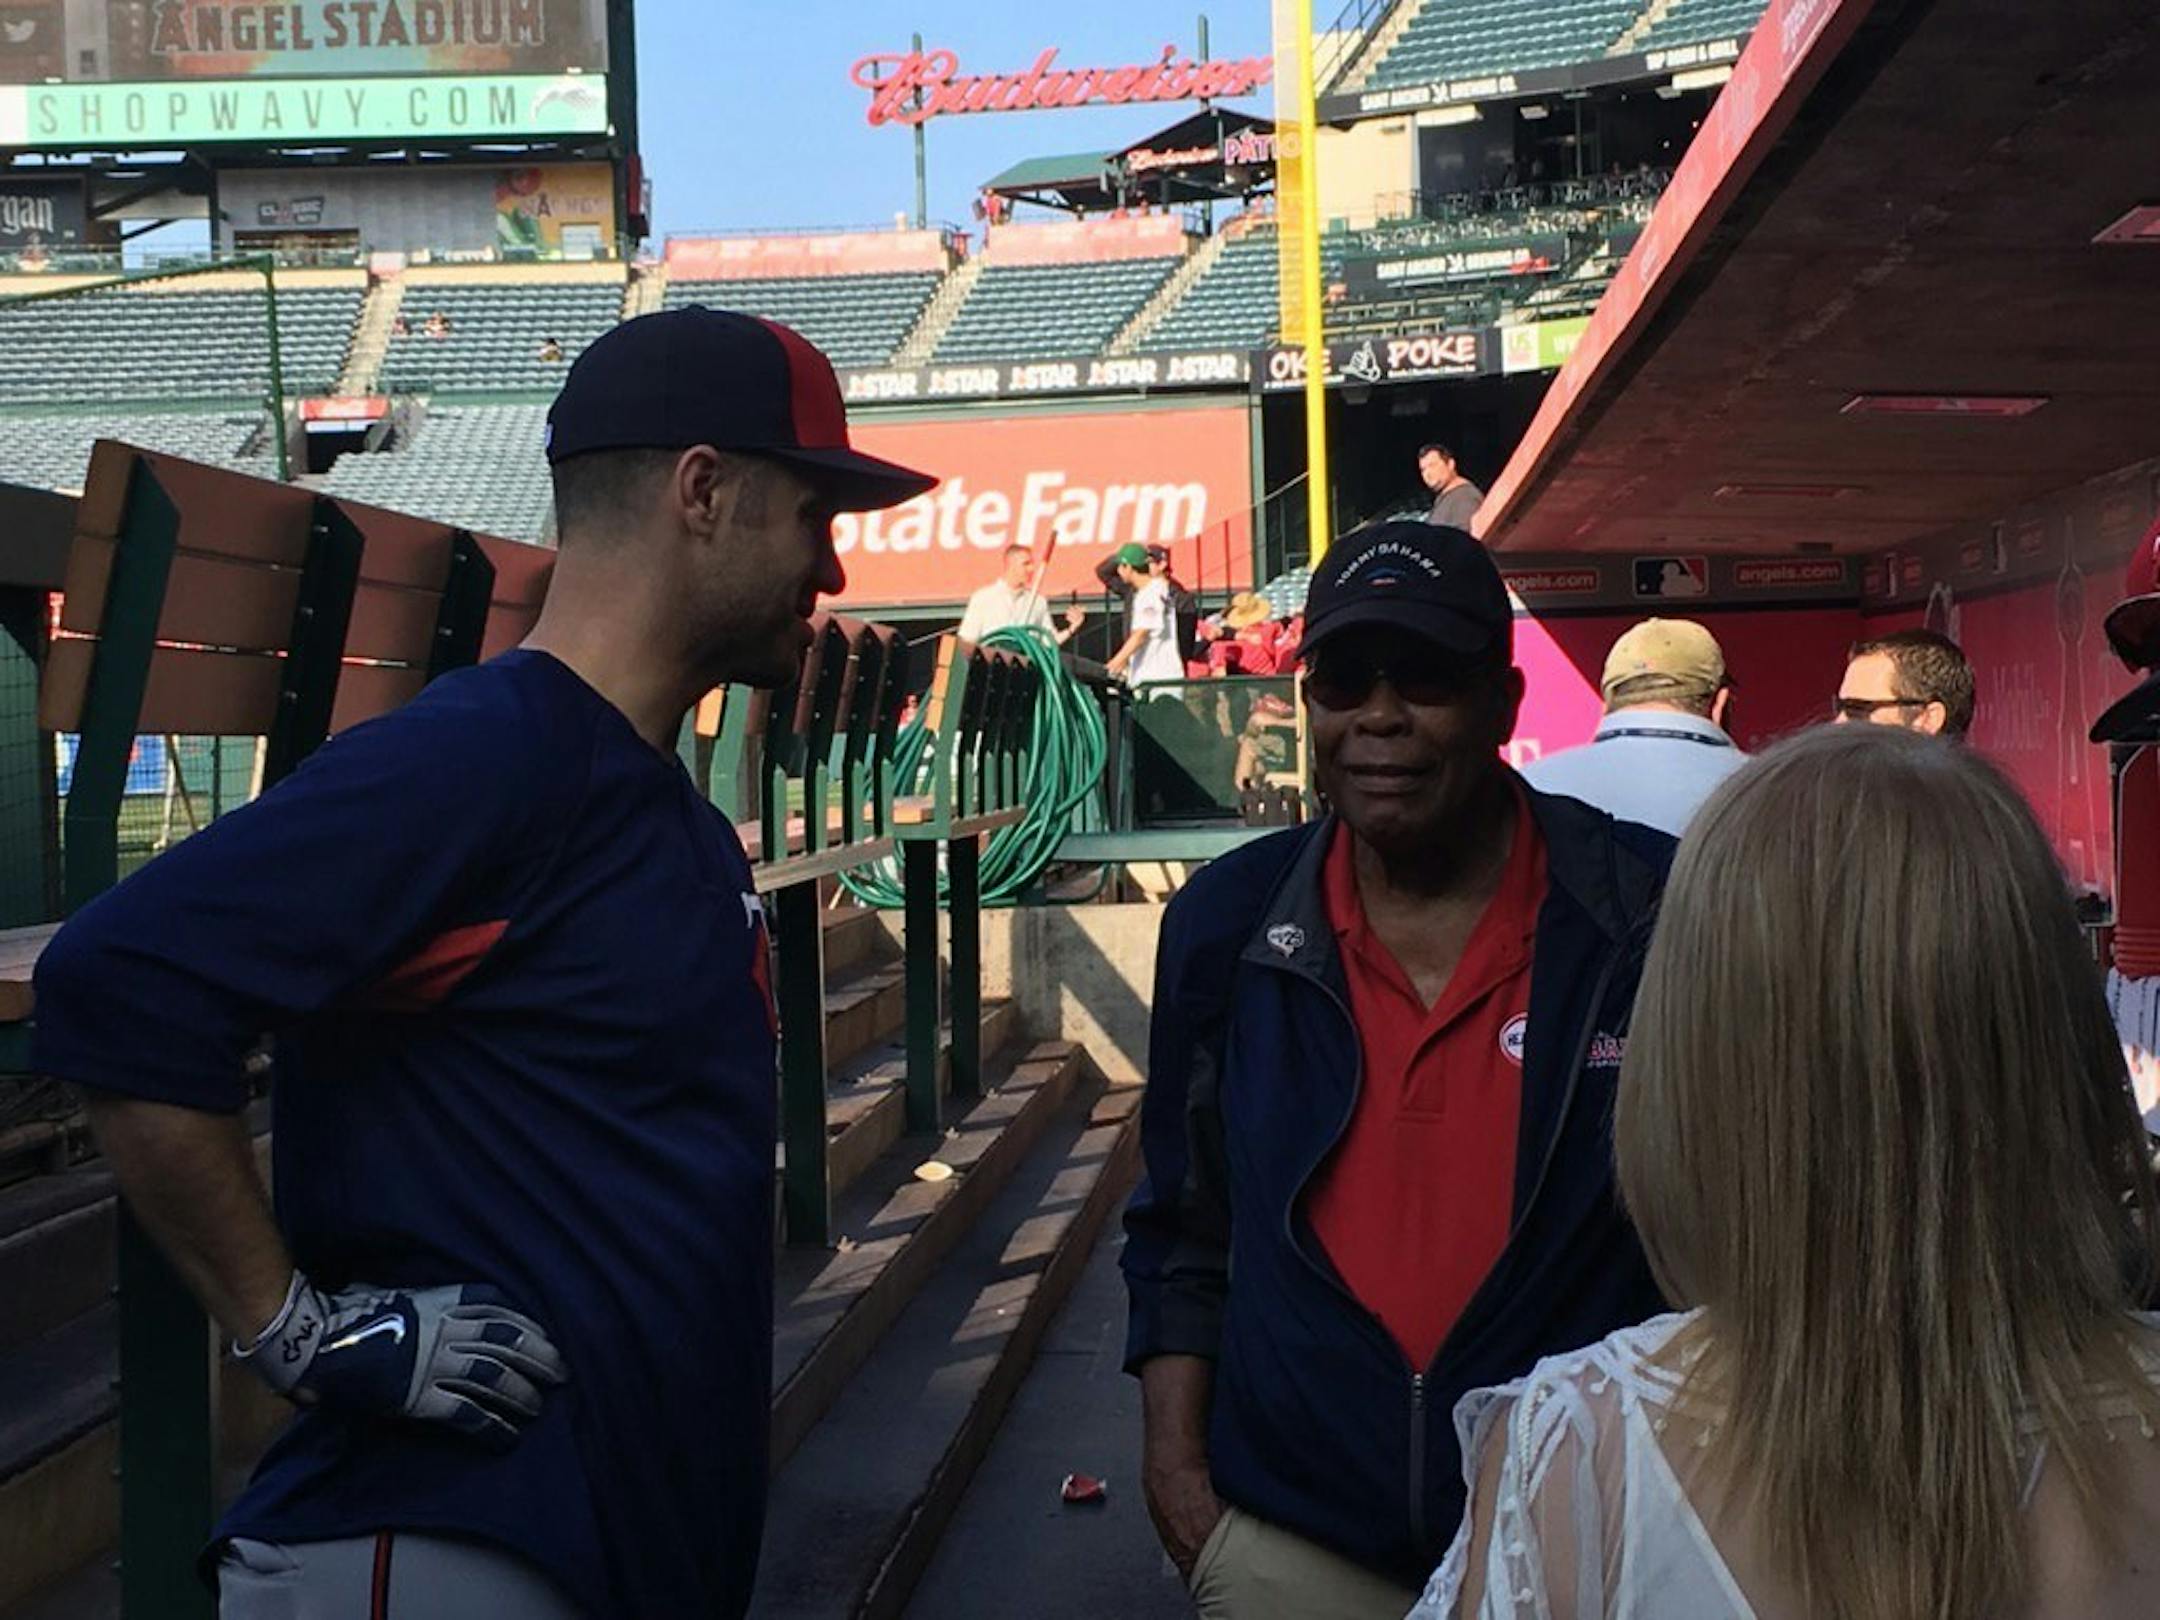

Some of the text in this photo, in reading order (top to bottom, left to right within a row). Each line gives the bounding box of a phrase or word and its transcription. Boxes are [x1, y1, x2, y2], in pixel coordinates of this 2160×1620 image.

[152, 0, 545, 53] ANGEL STADIUM
[850, 44, 1274, 127] Budweiser
[38, 85, 518, 134] SHOPWAVY.COM
[1387, 335, 1477, 369] POKE
[1502, 573, 1594, 593] ngels.com
[1739, 565, 1840, 586] angels.com
